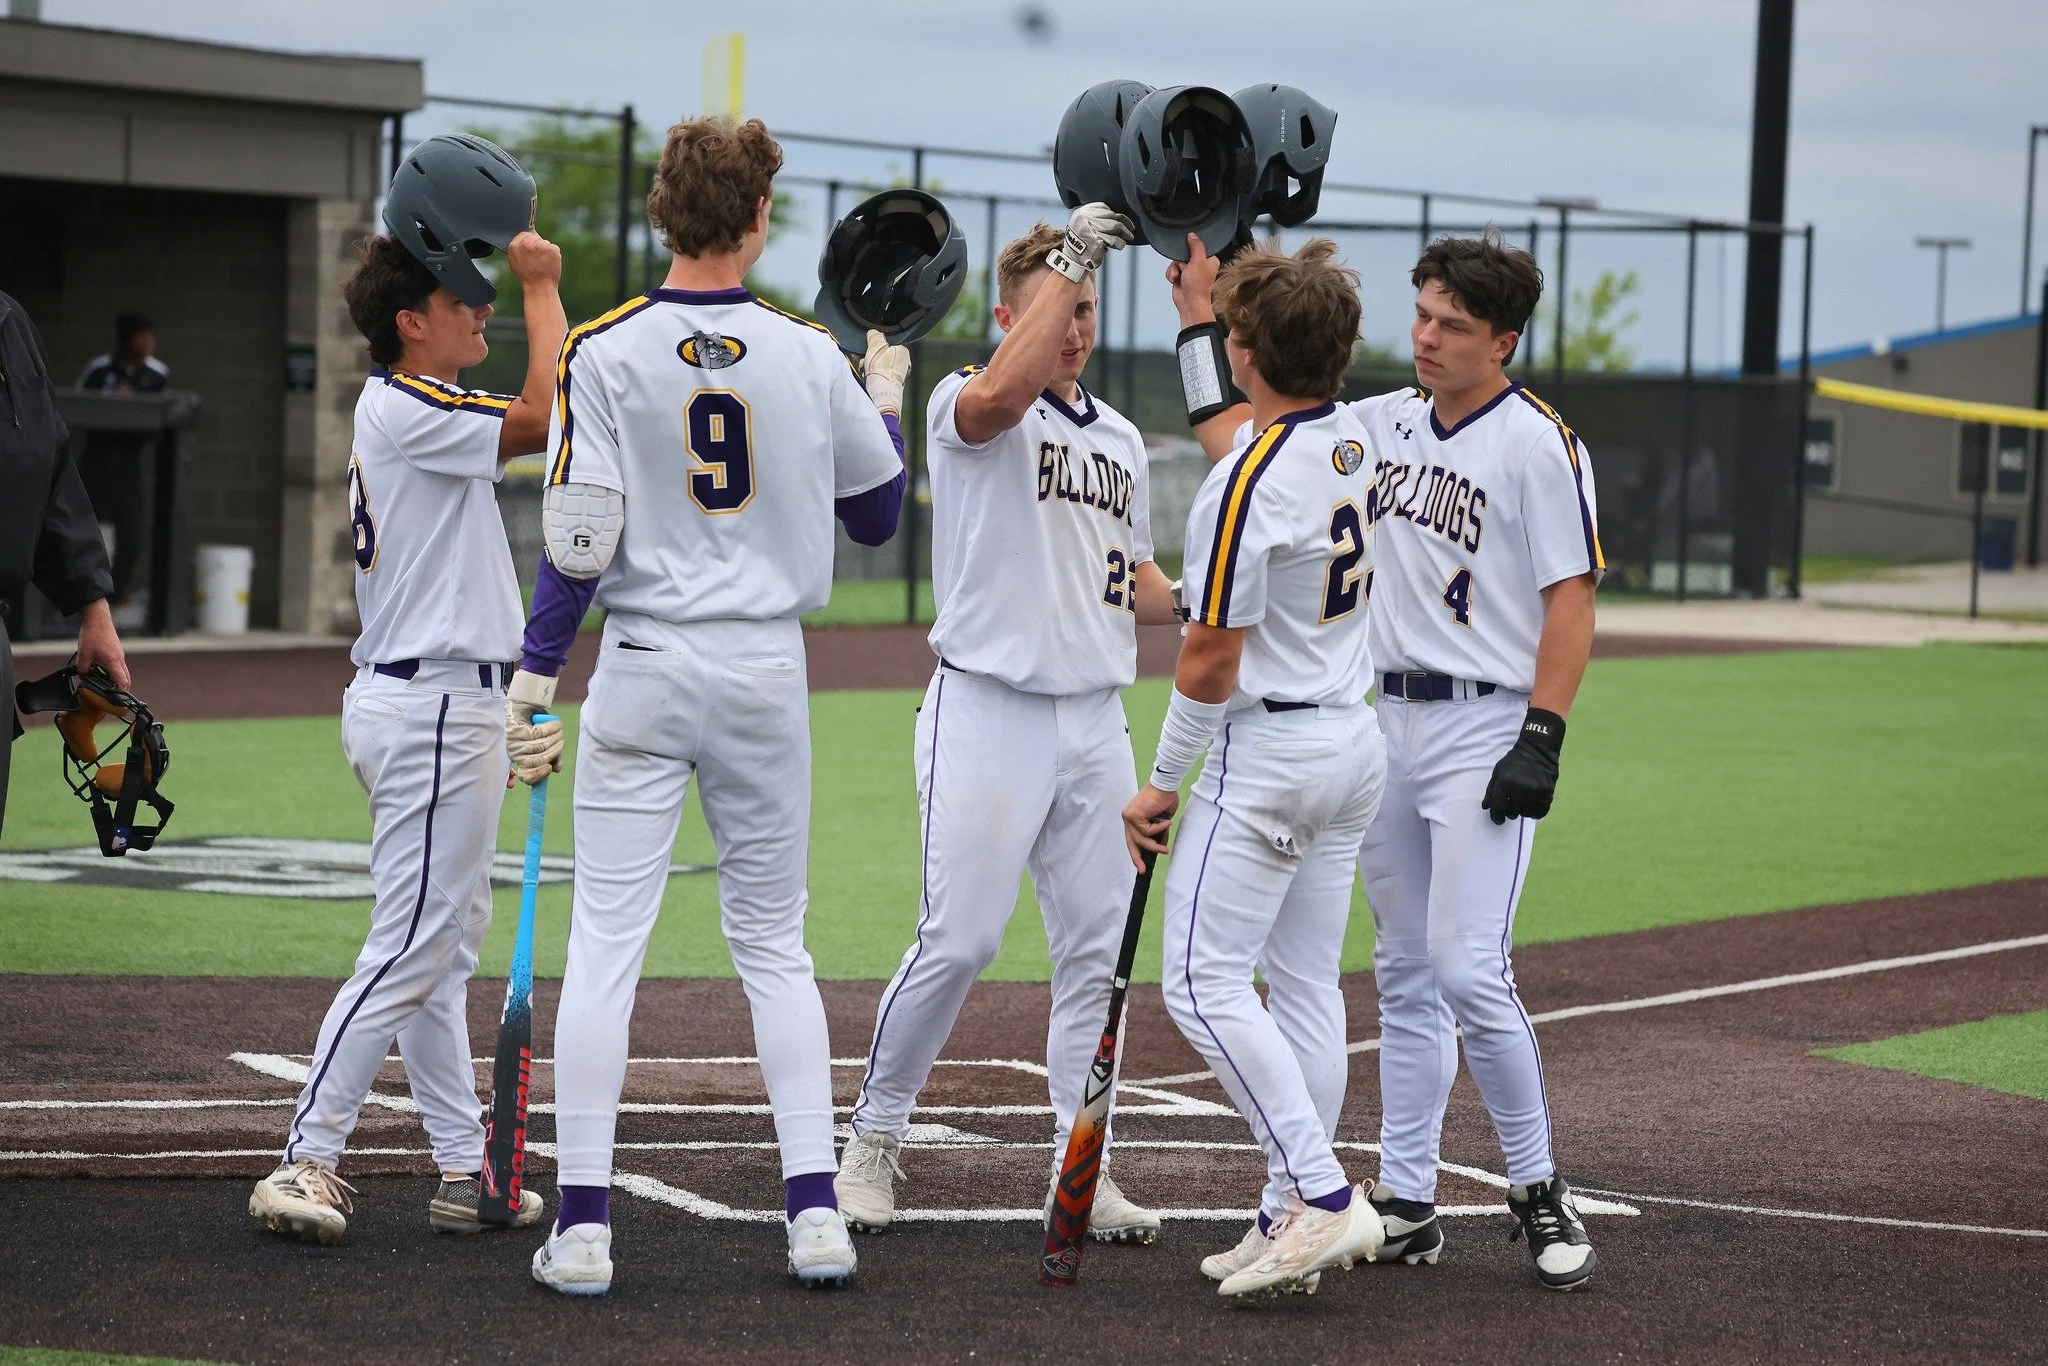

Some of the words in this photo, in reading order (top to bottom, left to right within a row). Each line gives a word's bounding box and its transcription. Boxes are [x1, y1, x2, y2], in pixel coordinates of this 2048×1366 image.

[684, 387, 756, 515] 9
[1318, 477, 1379, 625] 2
[1443, 566, 1474, 629] 4
